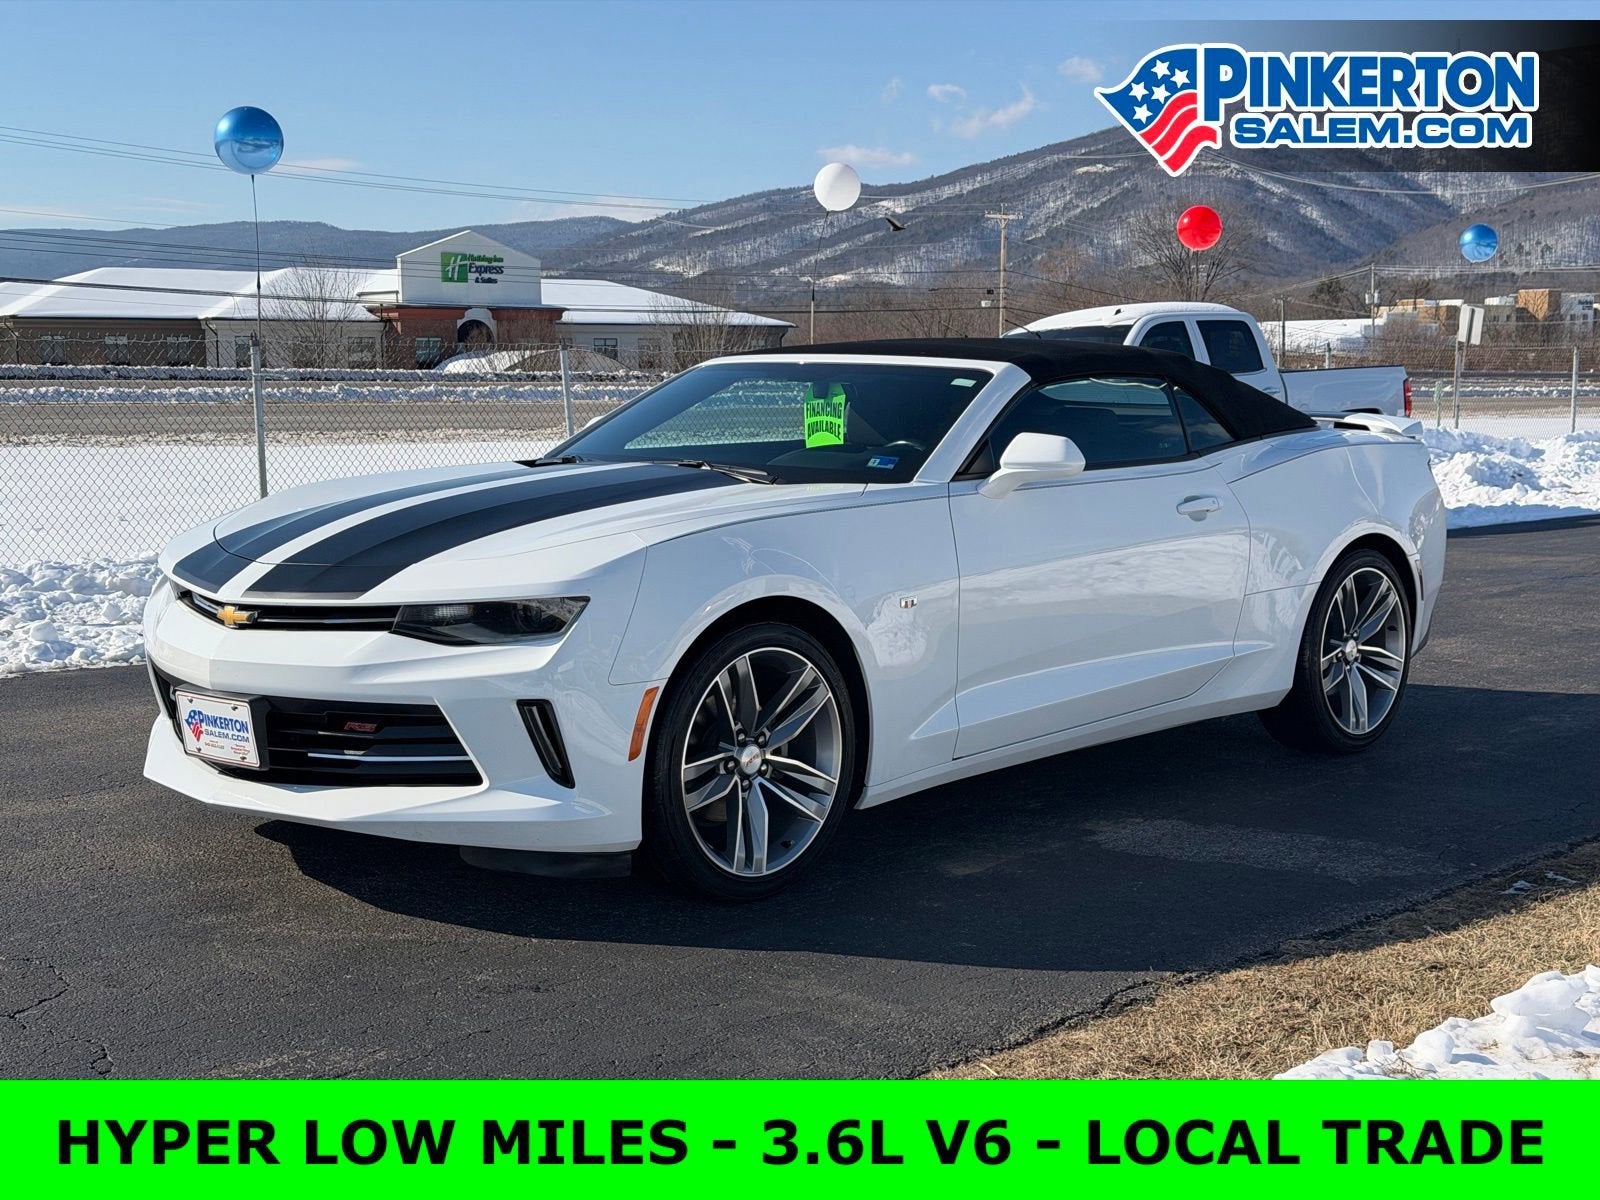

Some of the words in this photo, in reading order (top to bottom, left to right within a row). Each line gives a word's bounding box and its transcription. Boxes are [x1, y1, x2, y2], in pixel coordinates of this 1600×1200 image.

[469, 263, 504, 276] Express
[806, 401, 843, 419] FINANCING
[807, 420, 842, 440] AVAILABLE
[198, 710, 250, 734] PINKERTON
[204, 728, 250, 743] SALEM.COM
